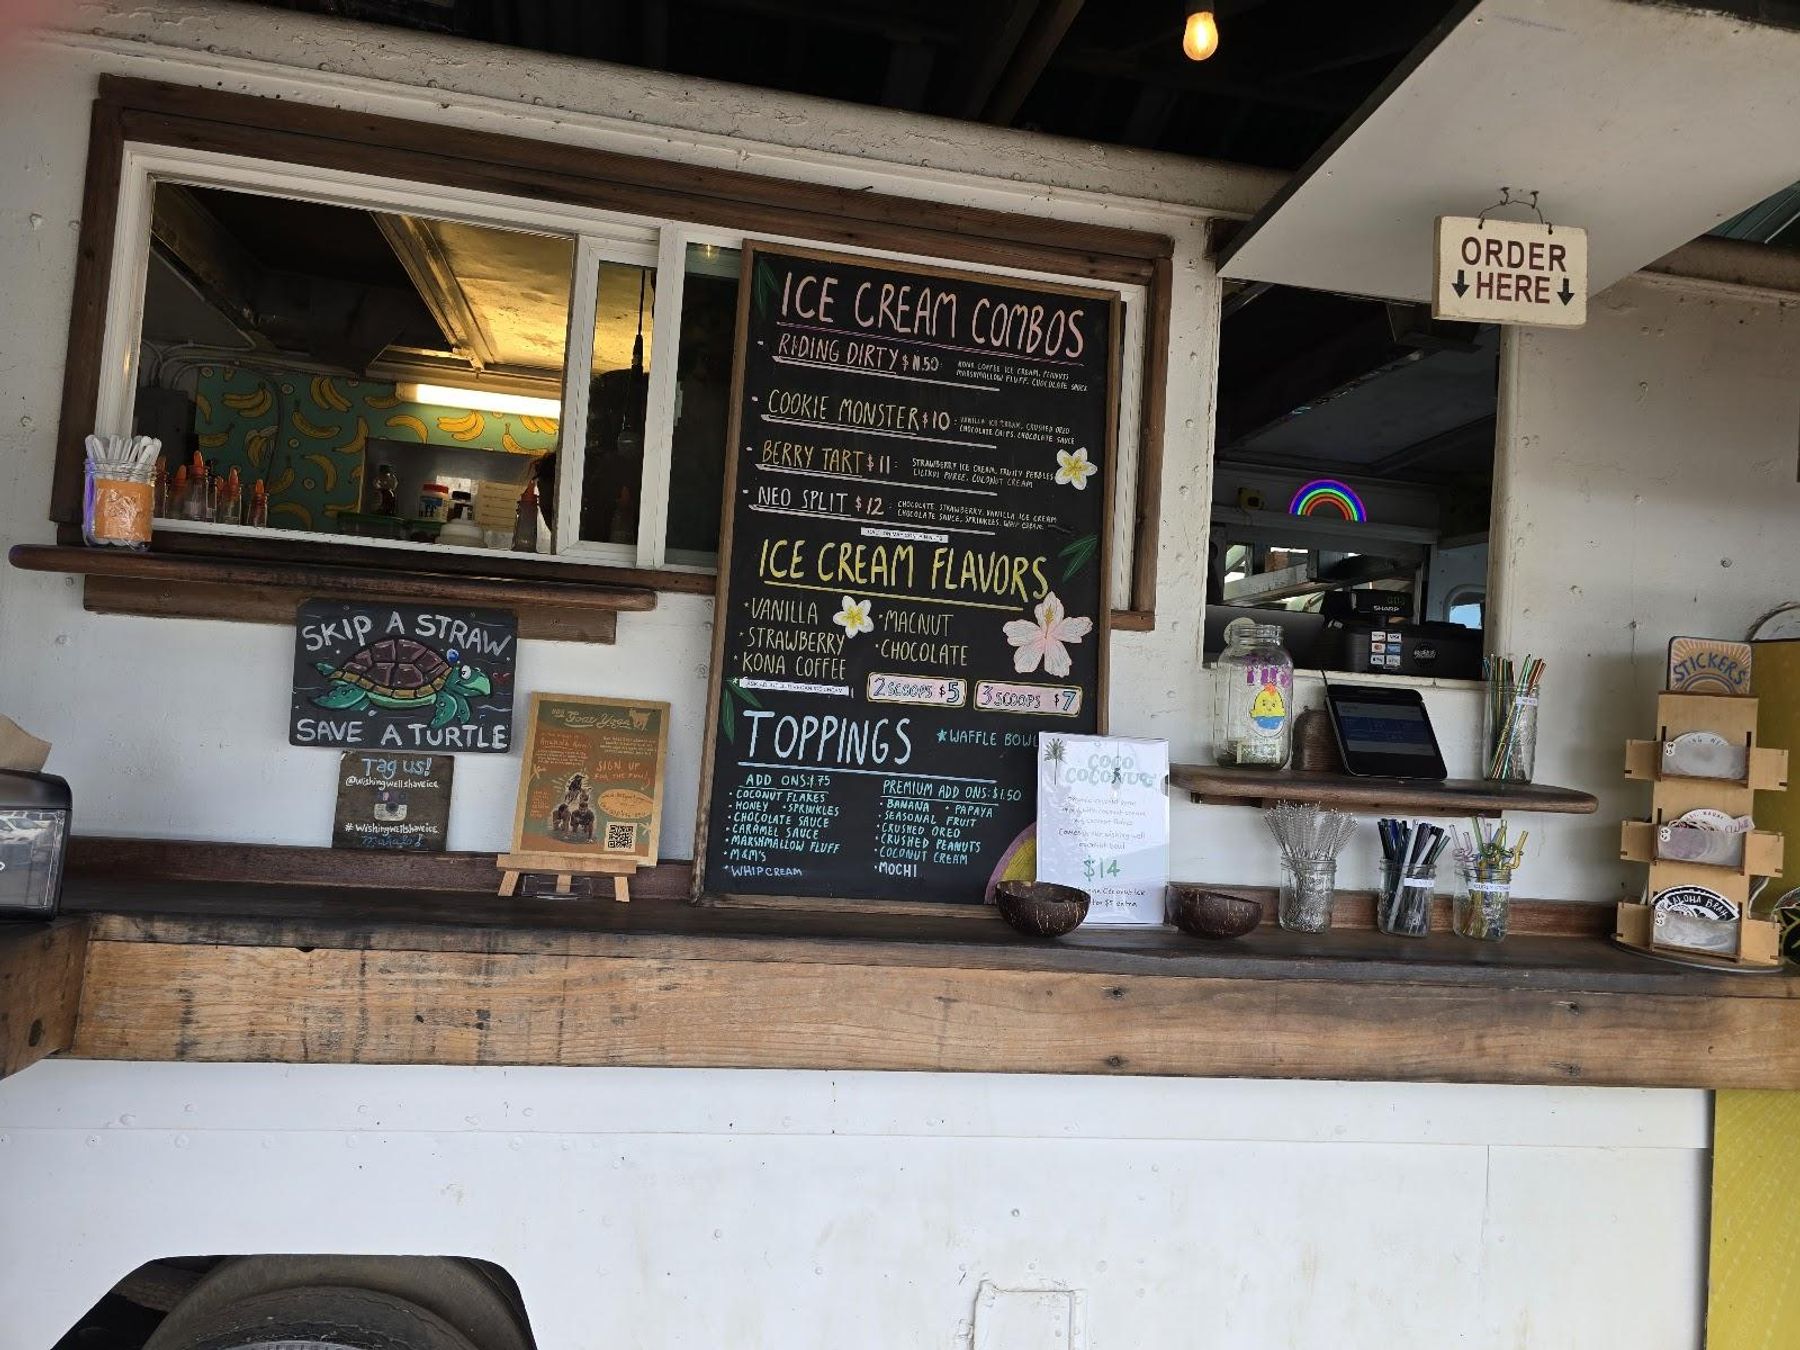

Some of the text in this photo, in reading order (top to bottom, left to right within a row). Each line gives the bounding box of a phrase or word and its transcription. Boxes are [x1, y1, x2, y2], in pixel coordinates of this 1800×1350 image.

[1461, 236, 1567, 272] ORDER
[1476, 271, 1550, 304] HERE
[782, 272, 1084, 358] ICE CREAM COMBOS
[778, 333, 839, 362] RIDING
[847, 342, 898, 370] DIRTY
[1004, 365, 1014, 374] ICE
[769, 389, 829, 420] COOKIE
[839, 398, 919, 430] MONSTER
[1057, 436, 1075, 445] SAUCE
[762, 439, 814, 468] BERRY
[822, 448, 864, 474] TART
[912, 457, 957, 471] STRAWBERRY
[959, 463, 970, 473] ICE
[1007, 477, 1033, 488] CREAM
[758, 486, 792, 507] NEO
[801, 489, 848, 513] SPLIT
[897, 508, 936, 521] CHOCOLATE
[1019, 513, 1030, 521] ICE
[1033, 515, 1057, 524] CREAM
[759, 539, 1049, 602] ICE CREAM FLAVORS
[751, 597, 818, 625] VANILLA
[302, 610, 512, 656] SKIP A STRAW
[884, 609, 954, 637] MACNUT
[747, 627, 845, 656] STRAWBERRY
[881, 639, 969, 667] CHOCOLATE
[742, 652, 847, 681] KONA COFFEE
[1673, 652, 1747, 685] STICKERS
[939, 681, 960, 704] $5
[1054, 690, 1077, 712] $7
[296, 718, 508, 749] SAVE A TURTLE
[743, 709, 912, 765] TOPPINGS
[950, 729, 997, 746] WAFFLE
[361, 758, 397, 780] Tag
[596, 761, 620, 772] SIGN
[345, 775, 439, 791] @wishingwellshaveice
[745, 774, 772, 786] ADD
[882, 779, 933, 797] PREMIUM
[938, 785, 960, 799] ADD
[736, 789, 825, 803] COCONUT FLAKES
[735, 802, 840, 817] HONEY SPRINKLES
[884, 810, 977, 827] SEASONAL FRUIT
[886, 799, 993, 818] BANANA PAPAYA
[733, 812, 830, 828] CHOCOLATE SAUCE
[732, 824, 819, 840] CARAMEL SAUCE
[882, 823, 961, 838] CRUSHED OREO
[731, 835, 840, 854] MARSHMALLOW FLUFF
[880, 833, 981, 853] CRUSHED PEANUTS
[879, 845, 968, 865] COCONUT CREAM
[878, 861, 917, 878] MOCHI
[1083, 855, 1120, 882] $14
